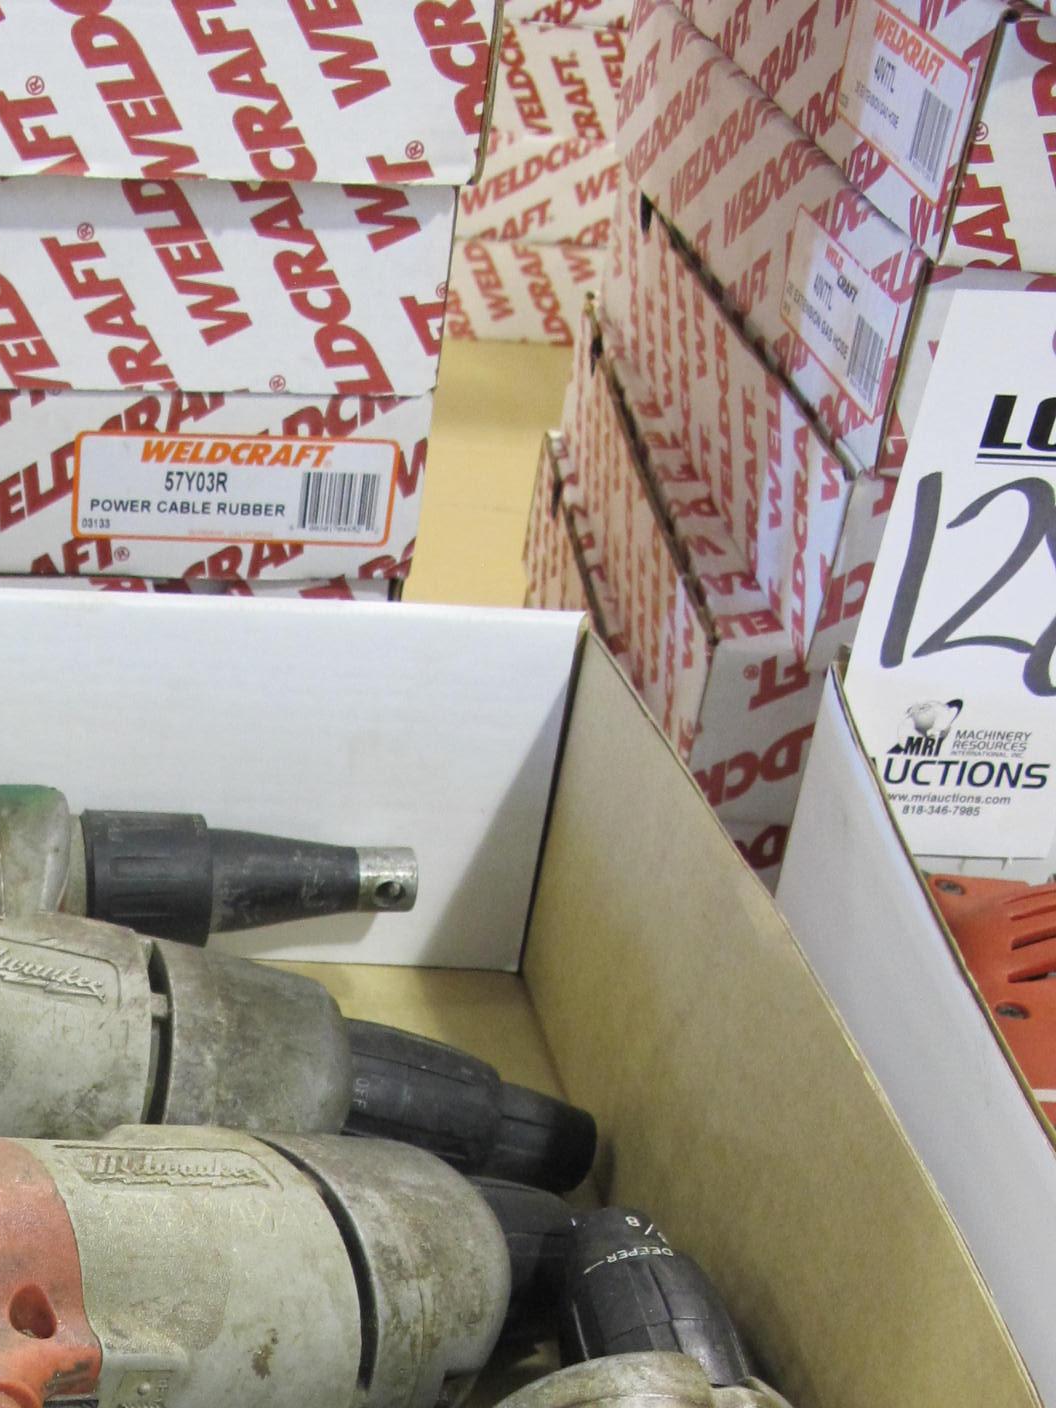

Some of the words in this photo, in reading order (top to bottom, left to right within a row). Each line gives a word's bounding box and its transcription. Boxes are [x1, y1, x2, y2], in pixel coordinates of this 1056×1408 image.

[140, 439, 335, 468] WELDCRAFT
[164, 471, 229, 494] 57Y03R
[90, 499, 152, 515] POWER
[156, 501, 212, 516] CABLE
[216, 503, 286, 519] RUBBER
[955, 729, 1032, 742] MACHINERY
[952, 740, 1028, 751] RESOURCES
[871, 757, 1051, 790] UCTIONS
[886, 792, 1011, 805] ww.mriauctions.com
[902, 805, 981, 816] 818-346-7985
[606, 1246, 674, 1263] DEEPER
